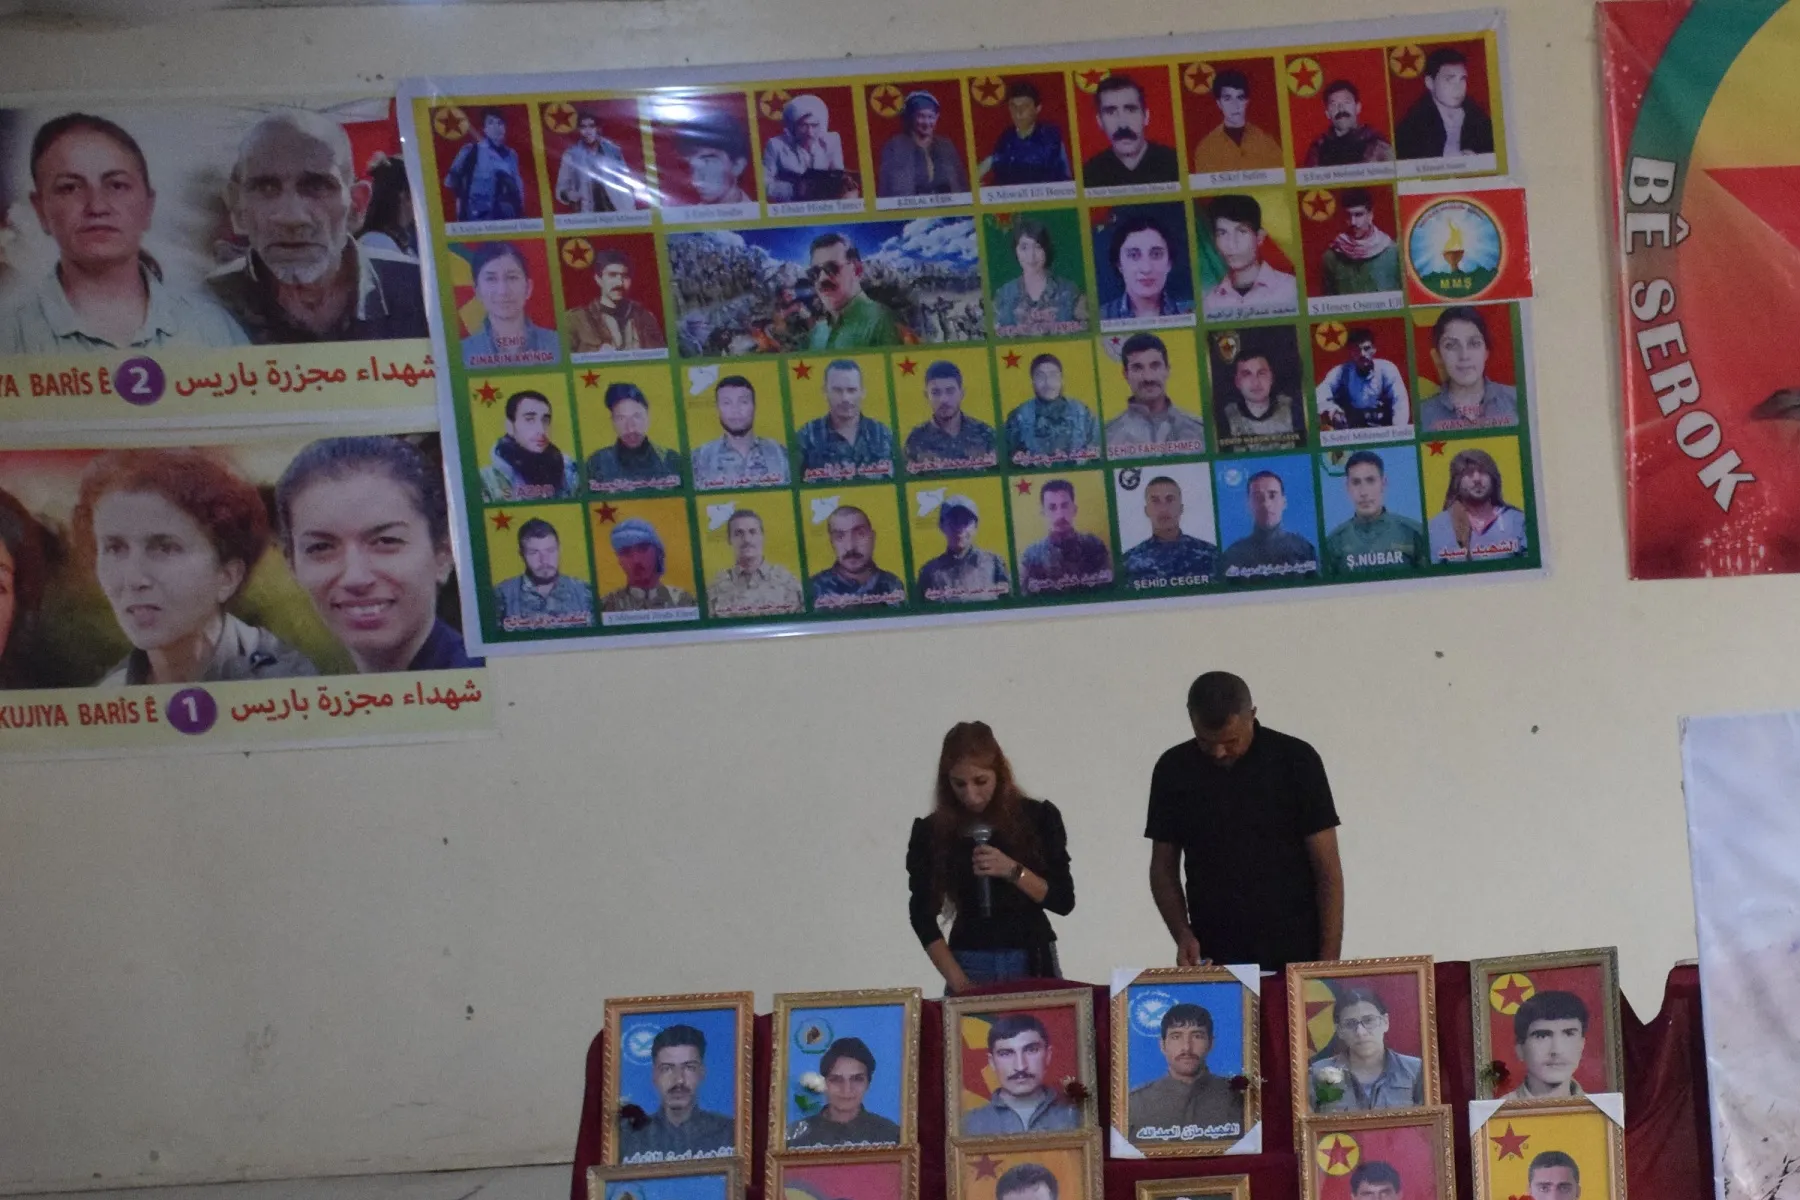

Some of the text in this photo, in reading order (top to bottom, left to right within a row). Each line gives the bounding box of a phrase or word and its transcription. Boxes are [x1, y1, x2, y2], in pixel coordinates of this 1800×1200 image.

[1626, 155, 1690, 255] BÊ
[129, 367, 153, 394] 2
[175, 355, 437, 397] شهداء مجزرة باريس
[1629, 279, 1756, 513] SEROK
[231, 681, 482, 723] شهداء مجزرة باريس
[1205, 1122, 1240, 1139] الشهيد
